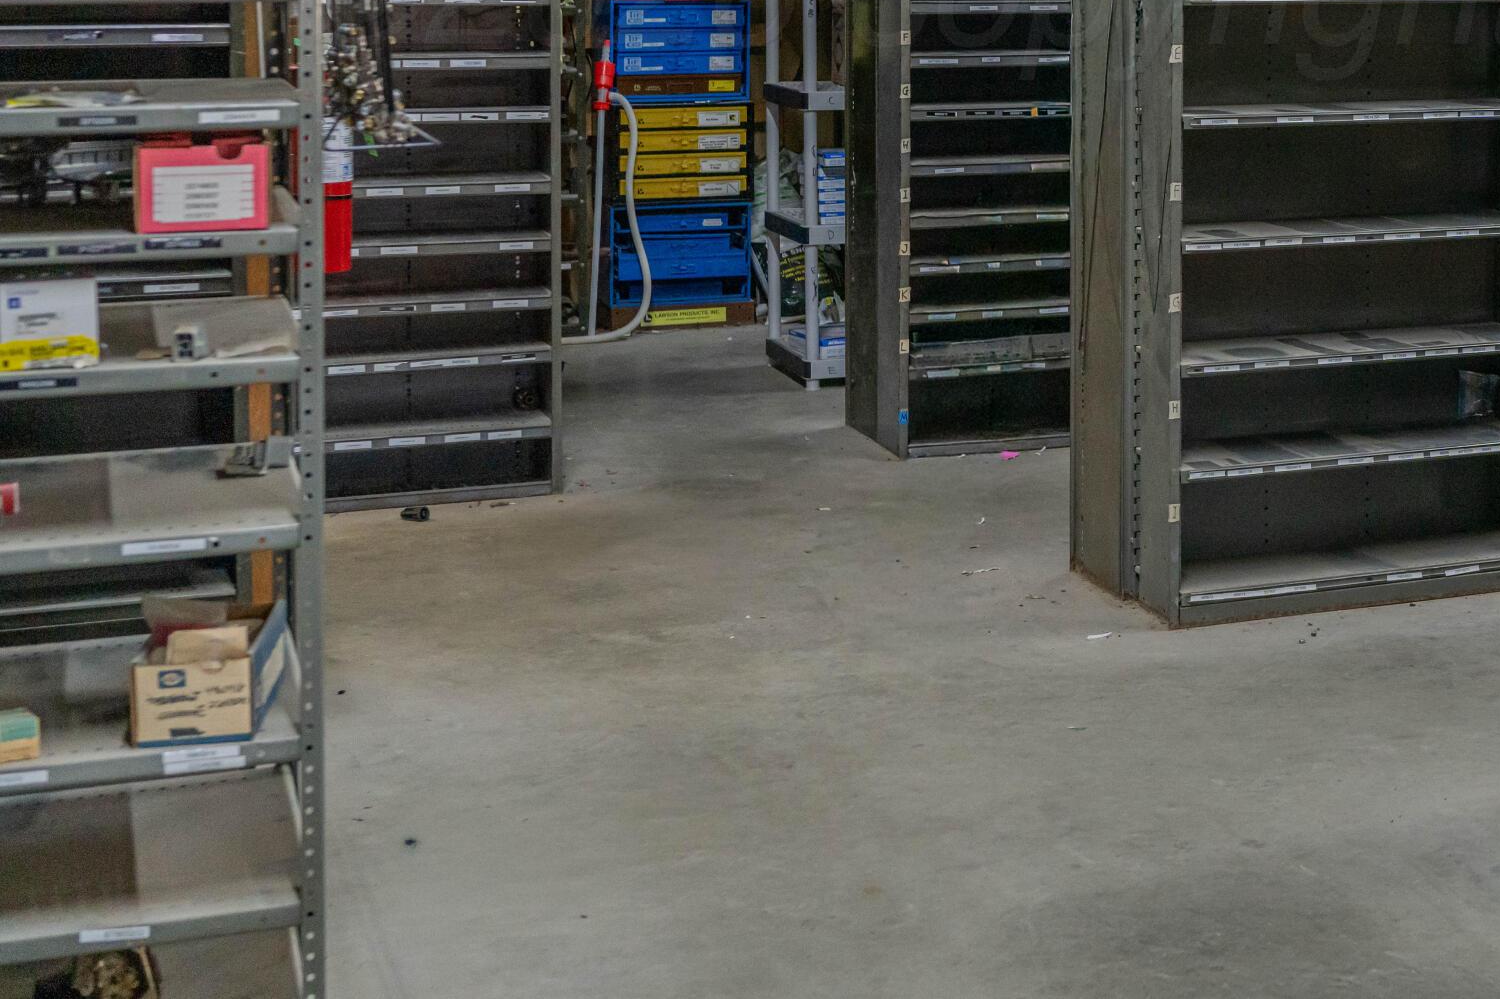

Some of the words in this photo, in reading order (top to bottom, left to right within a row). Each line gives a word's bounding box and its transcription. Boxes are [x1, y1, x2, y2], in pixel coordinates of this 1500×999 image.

[903, 33, 909, 42] F
[903, 86, 909, 96] G
[903, 141, 909, 150] H
[901, 243, 908, 254] J
[901, 290, 908, 301] K
[1172, 402, 1178, 413] H
